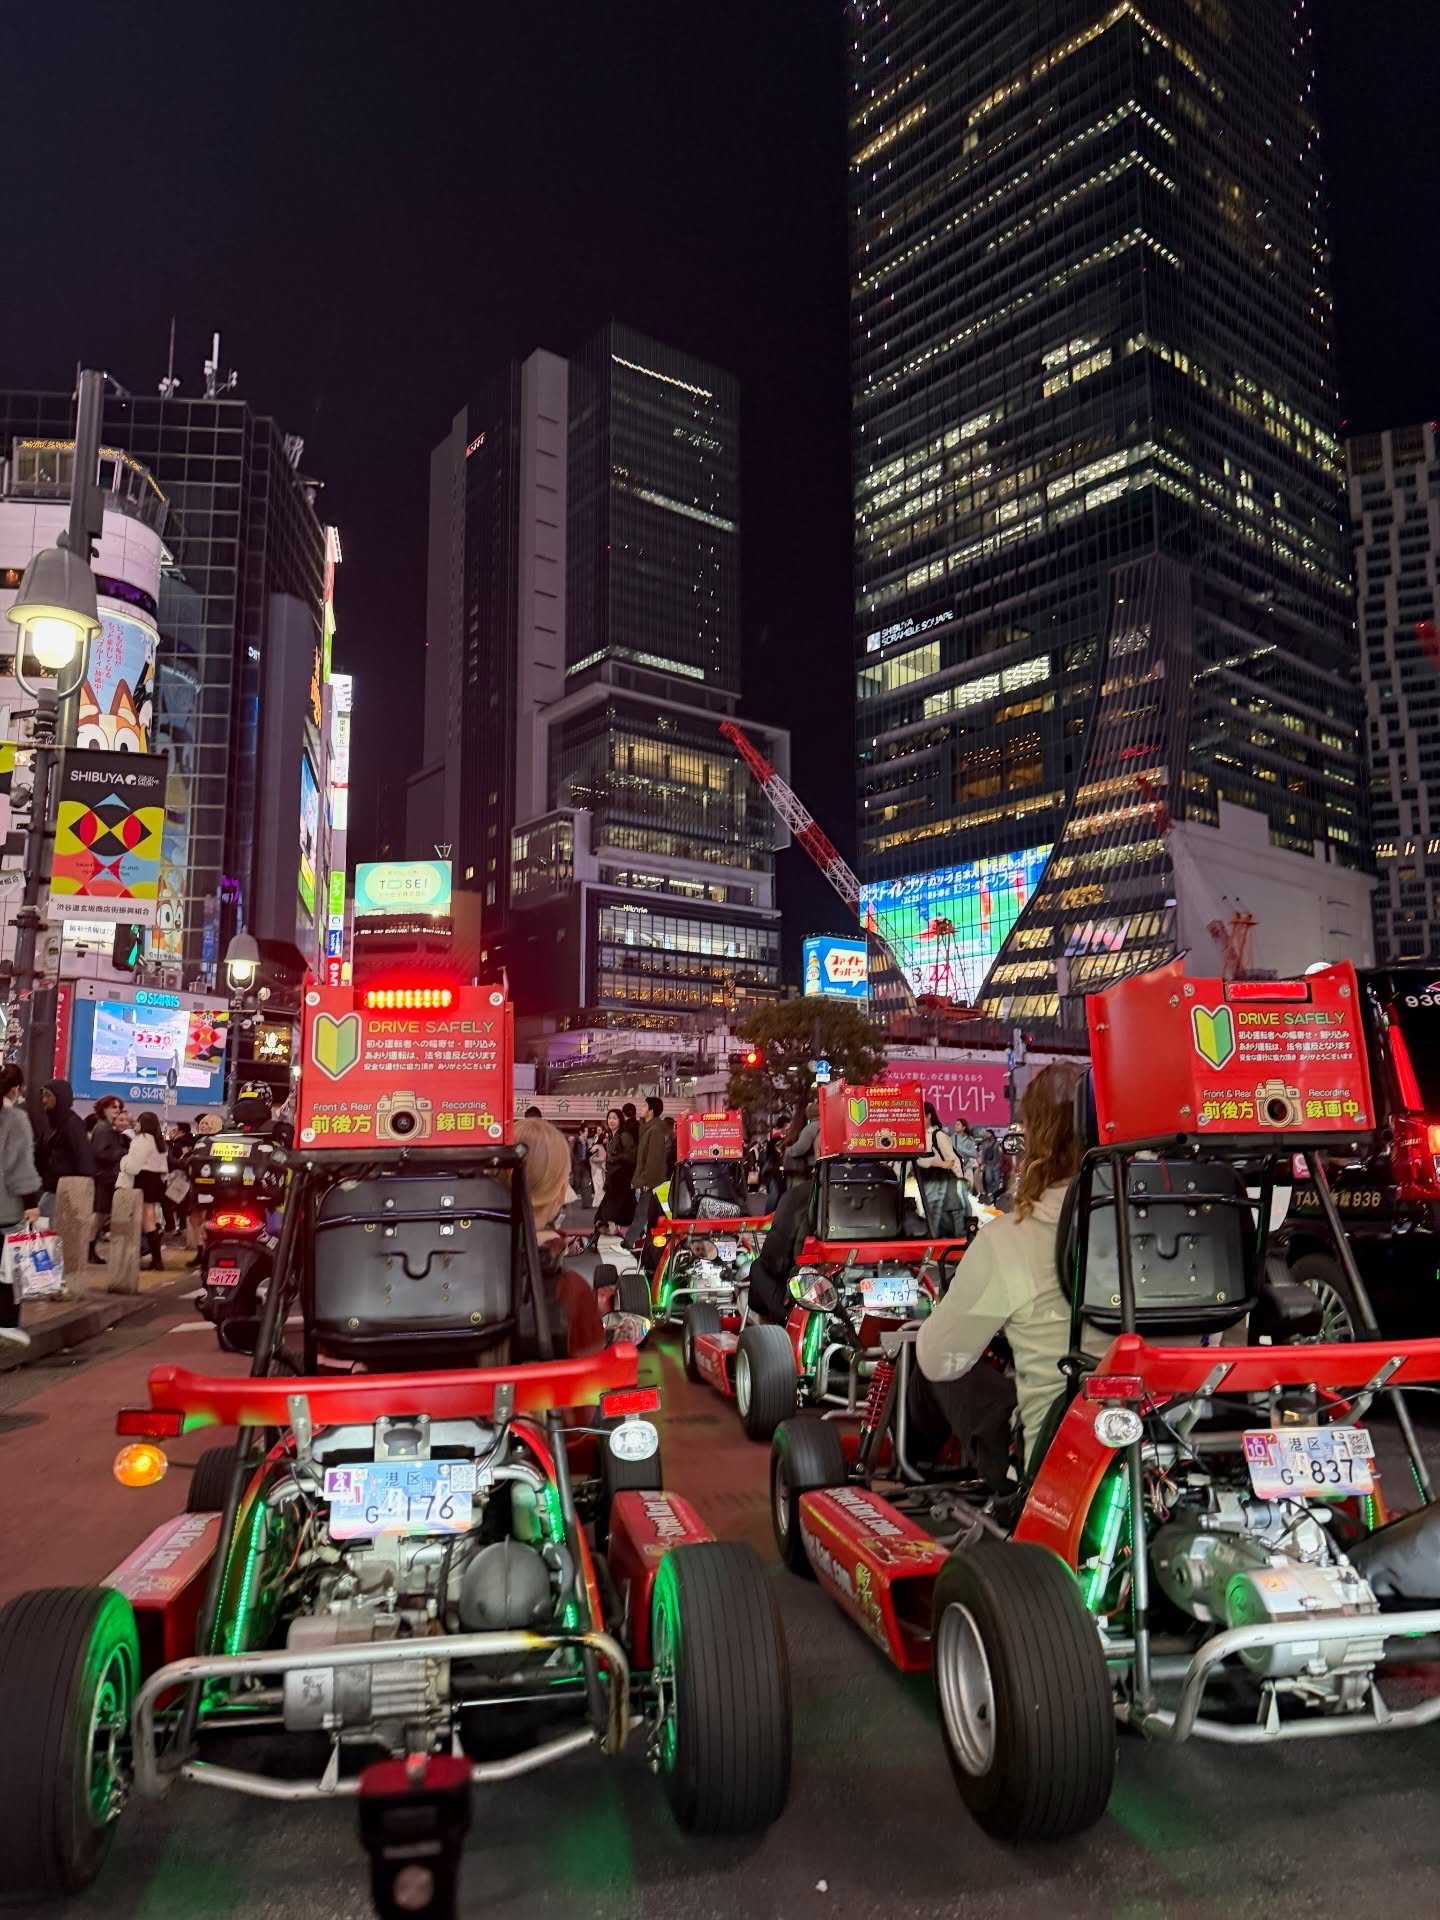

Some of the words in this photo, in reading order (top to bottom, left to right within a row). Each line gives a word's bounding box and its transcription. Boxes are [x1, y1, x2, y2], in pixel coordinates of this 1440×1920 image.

[881, 618, 913, 637] SHIBUYA
[881, 624, 920, 646] SCRAMBLE
[920, 609, 954, 631] SQUARE
[70, 770, 124, 785] SHIBUYA
[831, 954, 863, 966] ファイト
[147, 992, 180, 1008] STARTS
[1238, 1012, 1280, 1025] DRIVE
[1283, 1012, 1345, 1025] SAFELY
[368, 1020, 420, 1034] DRIVE
[425, 1020, 495, 1034] SAFELY
[141, 1087, 165, 1099] STAR
[1203, 1090, 1224, 1098] Front
[1226, 1090, 1233, 1098] &
[1308, 1089, 1350, 1097] Recording
[313, 1103, 337, 1112] Front
[340, 1103, 348, 1111] &
[350, 1102, 373, 1111] Rear
[441, 1101, 487, 1110] Recording
[1202, 1101, 1254, 1120] 前後方
[1306, 1099, 1359, 1119] 録画中
[311, 1114, 373, 1134] 前後方
[436, 1112, 495, 1132] 録画中
[1295, 1190, 1320, 1206] TAX
[890, 1291, 909, 1301] 797
[1249, 1444, 1265, 1457] 10
[1289, 1437, 1320, 1451] 港区
[385, 1471, 420, 1487] 港区
[1281, 1468, 1294, 1485] G
[1310, 1460, 1353, 1484] 837
[333, 1481, 346, 1492] 4
[365, 1505, 379, 1523] G
[406, 1495, 454, 1522] 176
